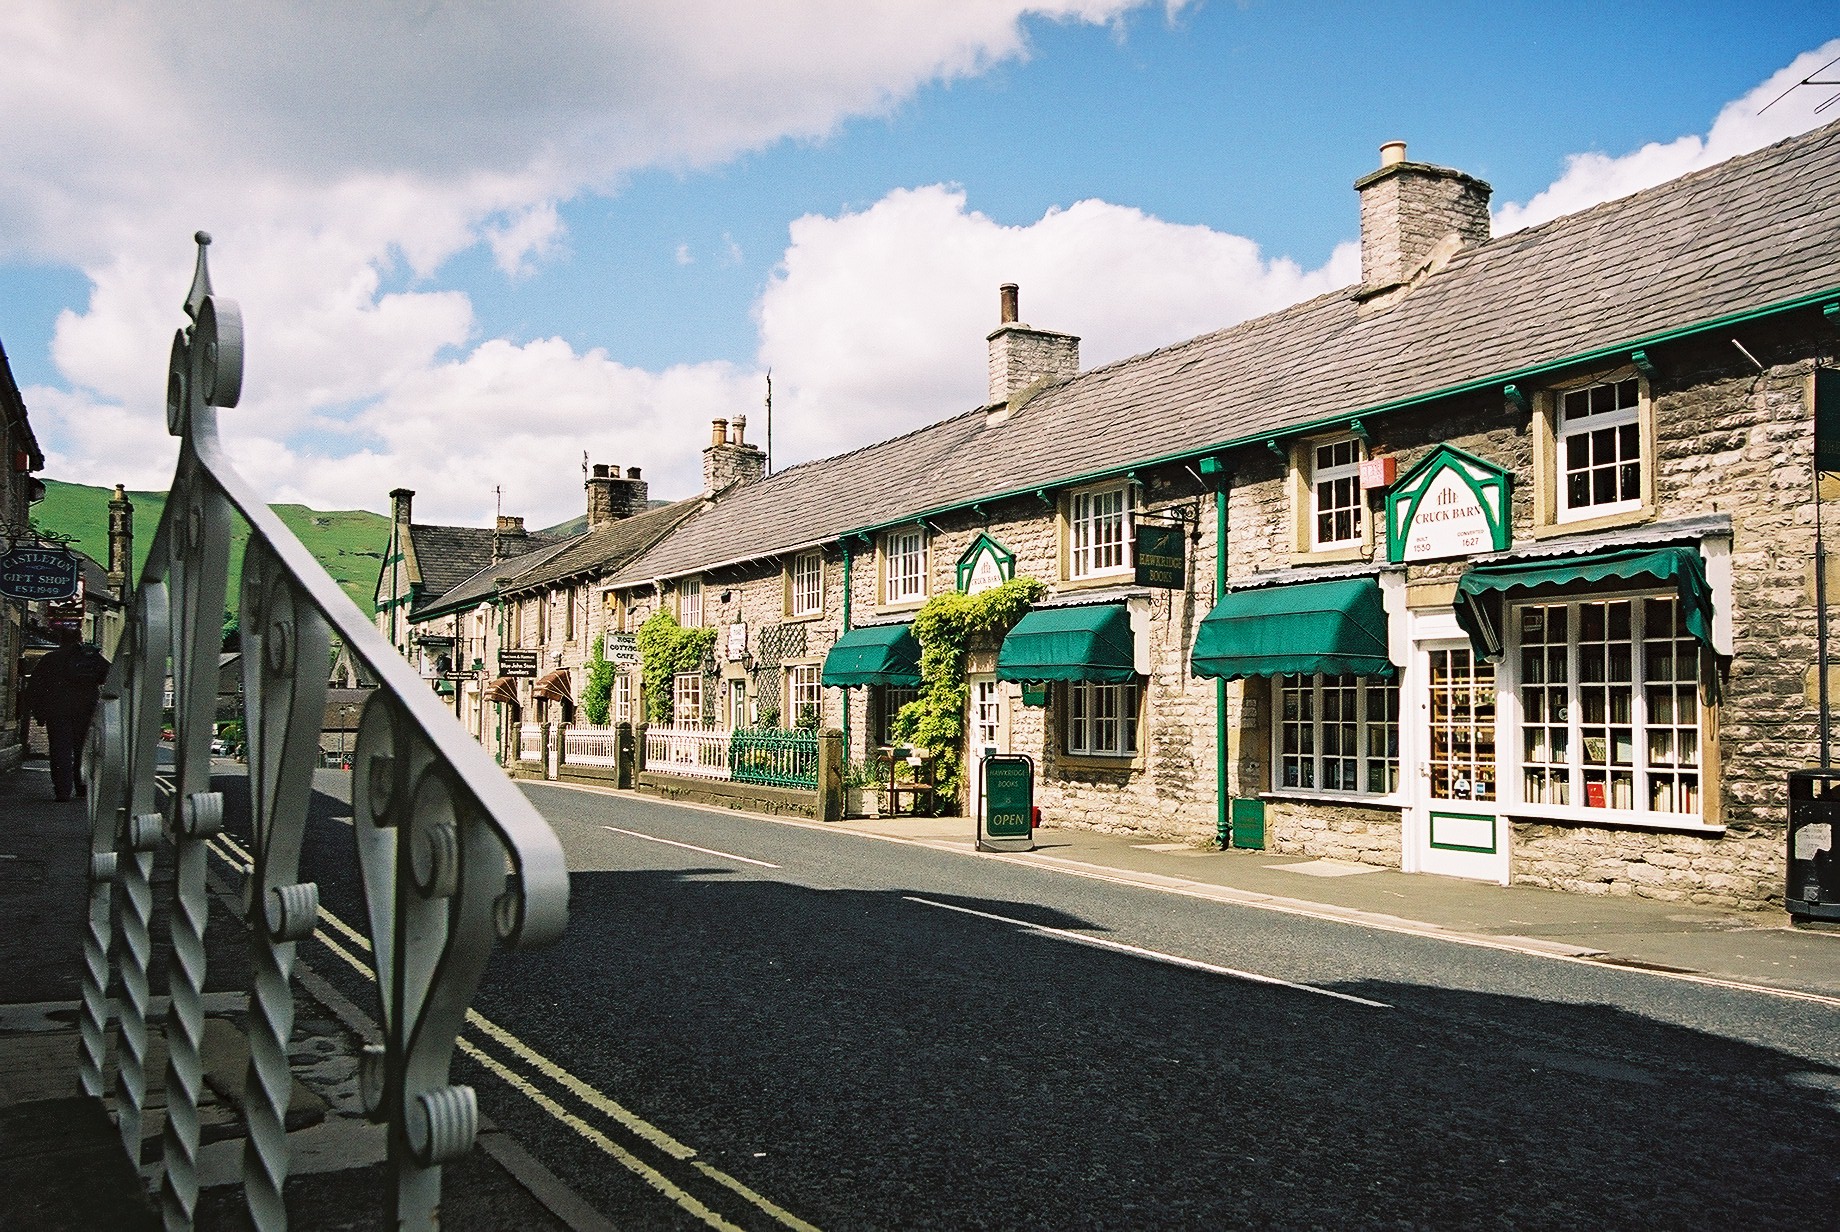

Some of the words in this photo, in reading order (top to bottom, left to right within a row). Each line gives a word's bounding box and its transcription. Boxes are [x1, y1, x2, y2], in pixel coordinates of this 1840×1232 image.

[1437, 488, 1459, 505] THE
[1416, 510, 1449, 524] CRUCK
[1452, 505, 1481, 518] BARN
[1462, 537, 1479, 546] 1627
[3, 554, 73, 571] CASTLETON
[3, 573, 33, 582] GIFT
[38, 575, 70, 584] SHOP
[998, 780, 1019, 788] BOOKS
[993, 814, 1024, 826] OPEN
